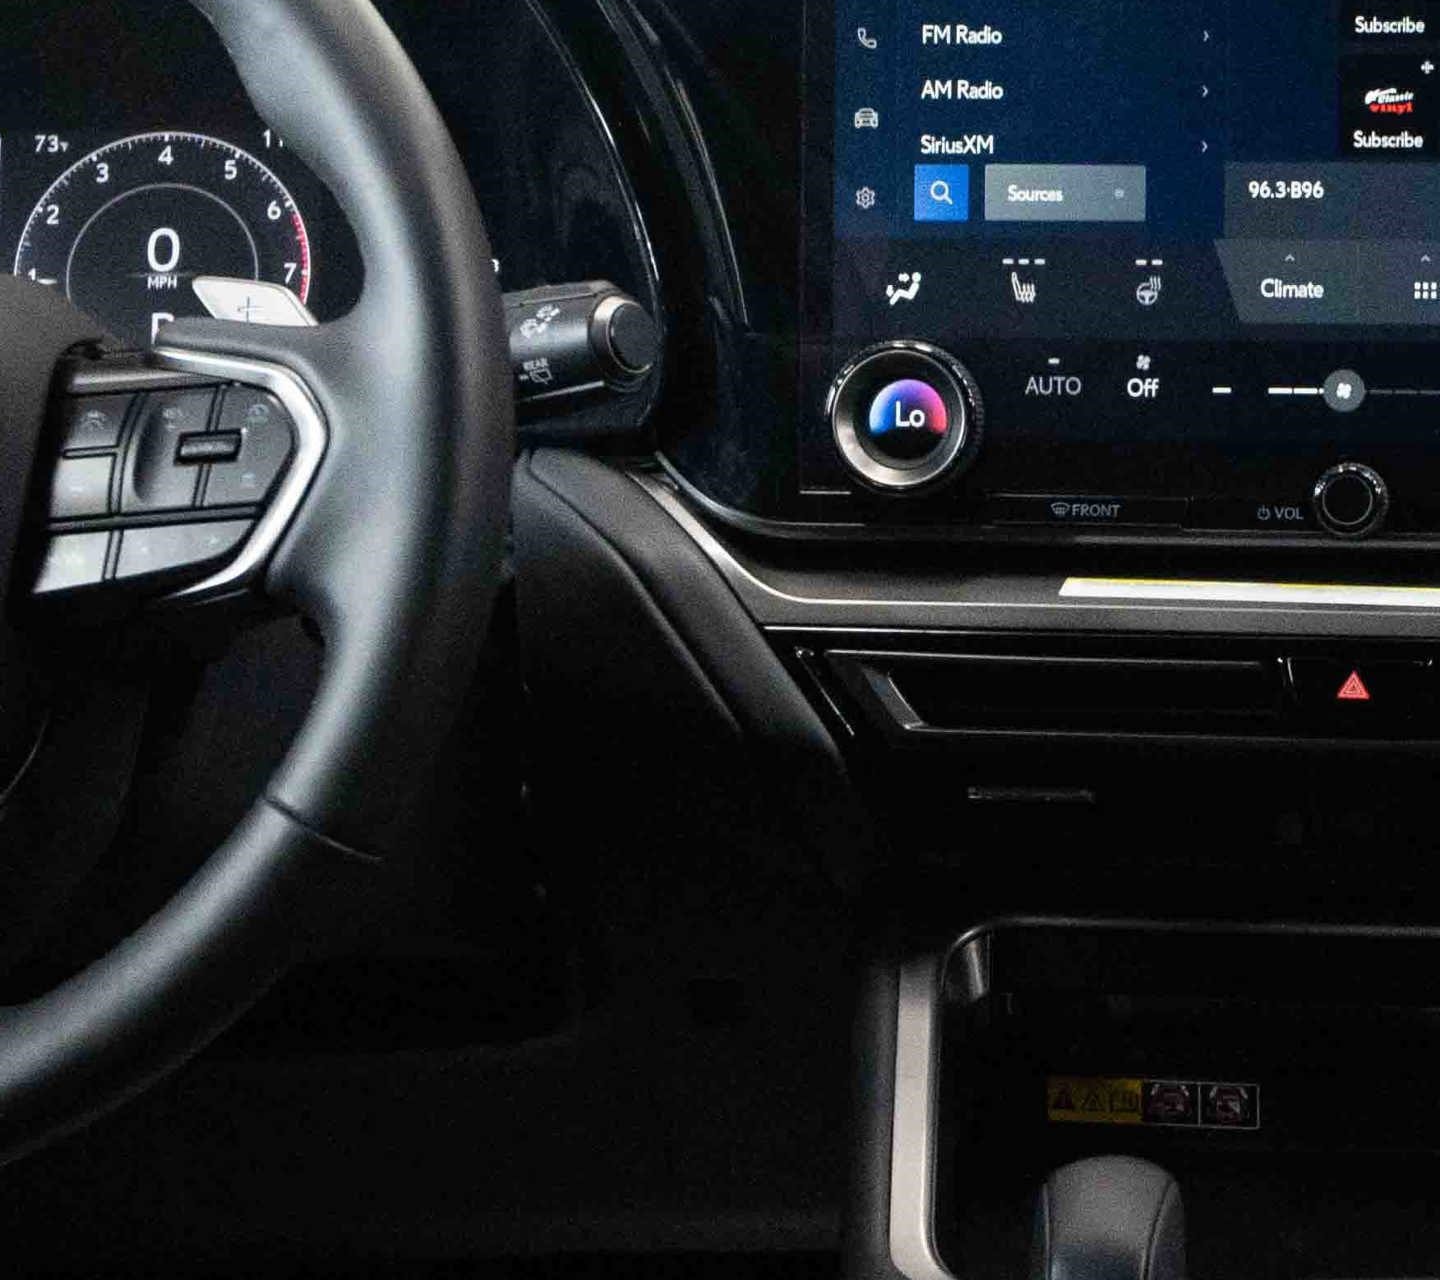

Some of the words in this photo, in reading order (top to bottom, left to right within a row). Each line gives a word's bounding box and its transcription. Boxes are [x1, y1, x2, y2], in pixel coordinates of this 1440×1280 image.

[921, 23, 952, 45] FM
[955, 23, 1004, 45] Radio
[1354, 15, 1426, 34] Subscribe
[920, 79, 953, 100] AM
[956, 79, 1005, 100] Radio
[919, 134, 995, 154] SiriusXM
[1352, 129, 1425, 149] Subscribe
[157, 145, 175, 166] 4
[95, 162, 109, 183] 3
[224, 159, 238, 180] 5
[1006, 183, 1064, 203] Sources
[46, 204, 60, 225] 2
[266, 200, 282, 221] 6
[146, 226, 181, 272] 0
[146, 275, 178, 290] MPH
[283, 262, 297, 284] 7
[1260, 277, 1325, 299] Climate
[1024, 375, 1082, 396] AUTO
[1127, 377, 1160, 398] Off
[895, 401, 926, 429] Lo
[1071, 503, 1121, 518] FRONT
[1275, 506, 1305, 521] VOL
